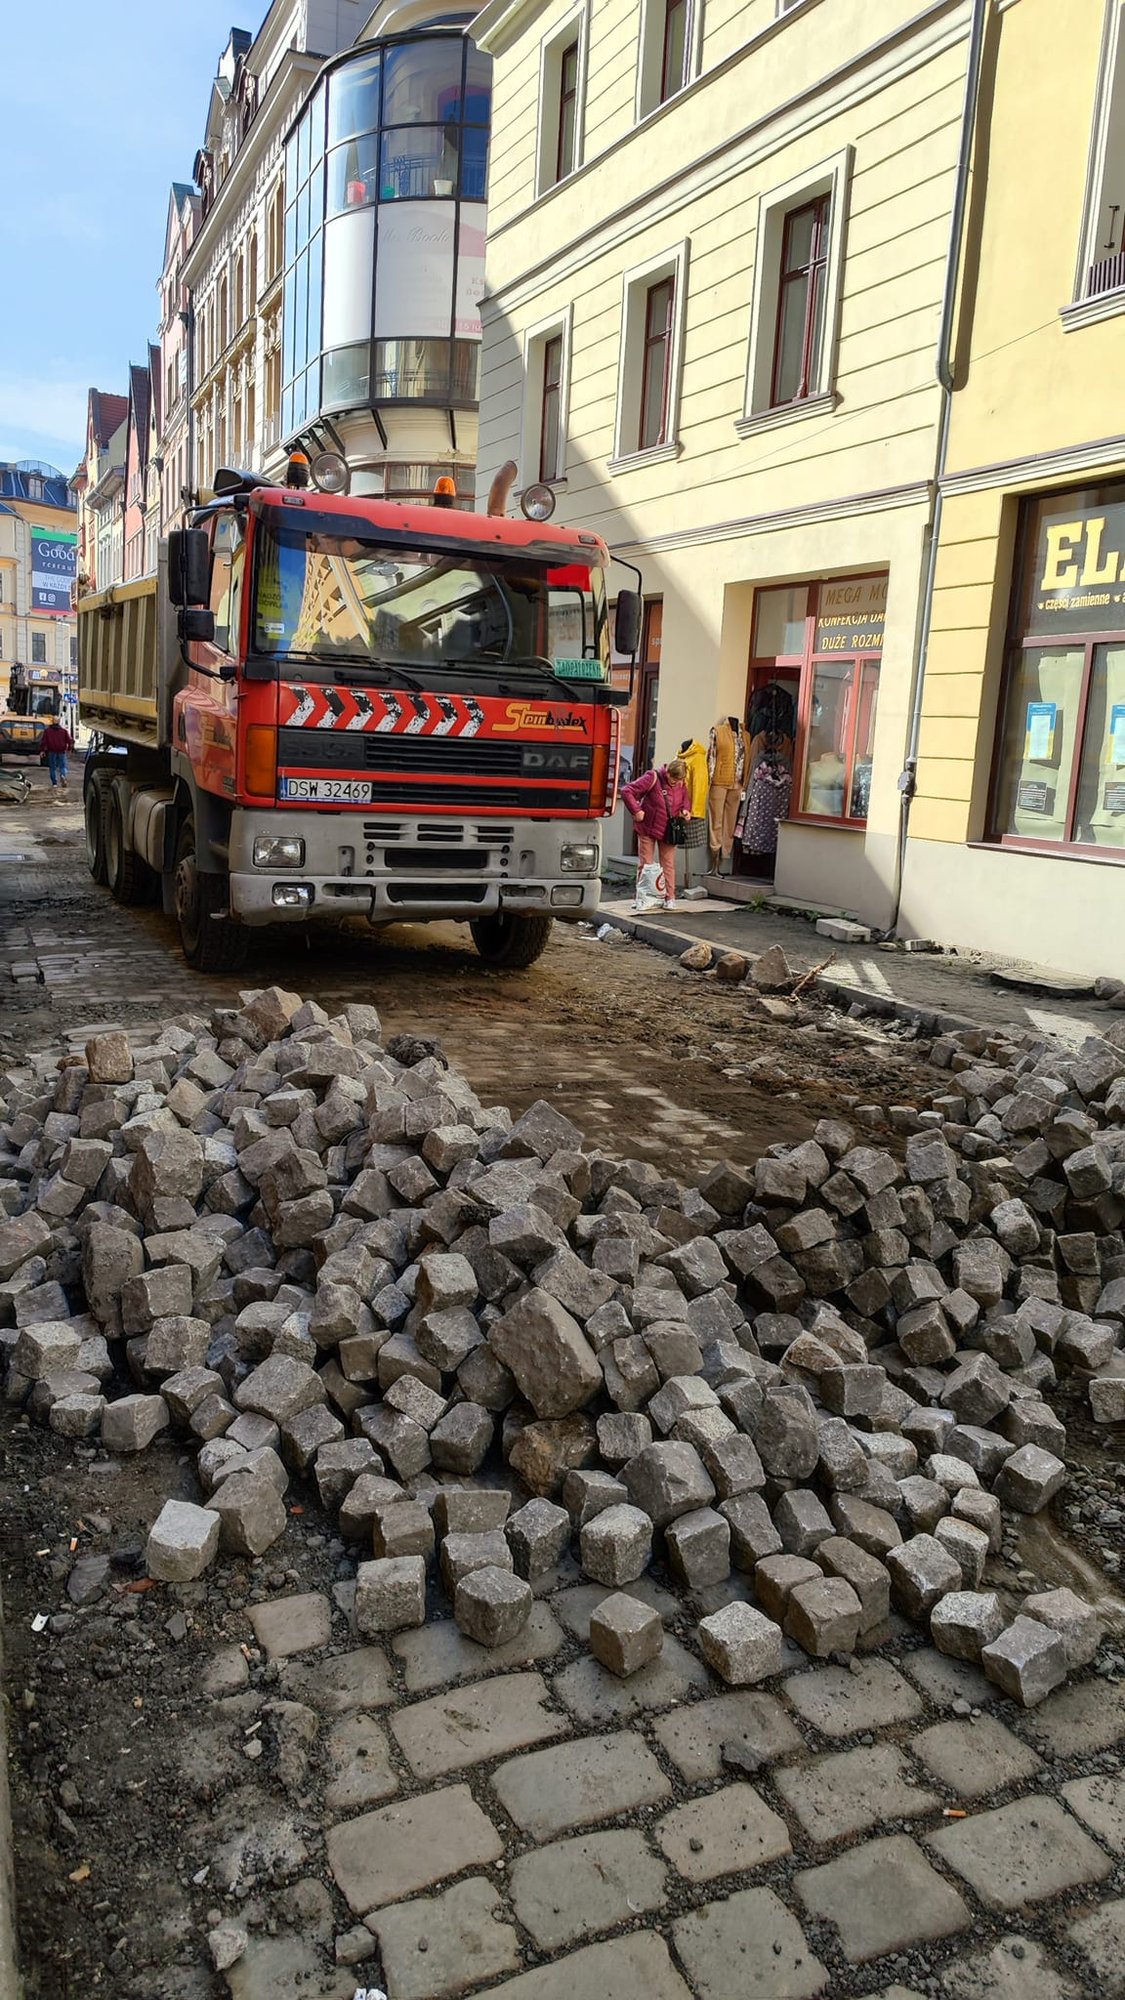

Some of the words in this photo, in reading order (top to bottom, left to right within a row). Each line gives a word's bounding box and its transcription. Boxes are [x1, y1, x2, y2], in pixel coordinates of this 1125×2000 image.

[826, 587, 862, 606] MEGA
[1070, 592, 1111, 608] zamienne
[821, 633, 847, 650] DUŻE
[523, 752, 590, 768] DAF
[288, 780, 319, 797] DSW
[323, 782, 371, 799] 32469
